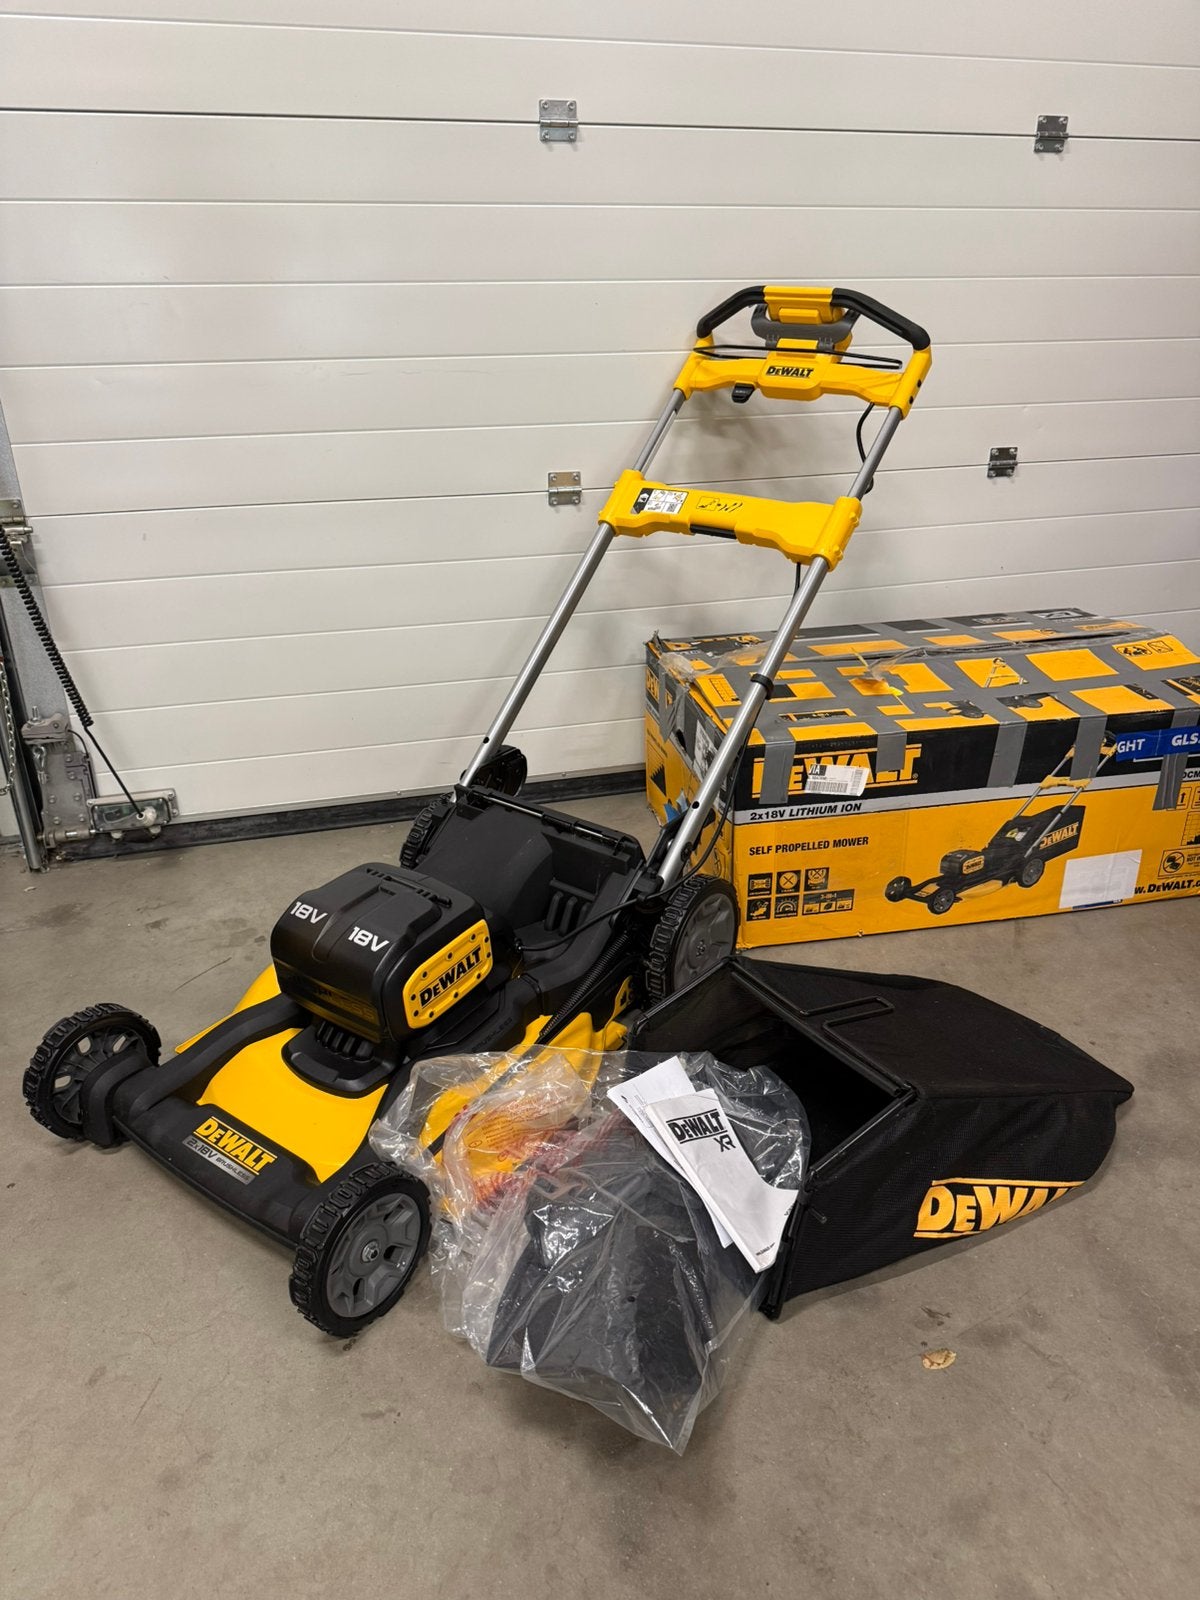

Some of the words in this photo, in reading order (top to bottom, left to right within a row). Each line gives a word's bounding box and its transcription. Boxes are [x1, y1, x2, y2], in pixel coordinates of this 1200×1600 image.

[766, 365, 814, 379] DEWALT
[750, 809, 786, 821] 2x18V
[788, 804, 838, 818] LITHIUM
[840, 802, 863, 813] ION
[748, 845, 773, 856] SELF
[774, 839, 830, 854] PROPELLED
[832, 836, 869, 848] MOWER
[289, 900, 329, 925] 18V
[347, 926, 390, 953] 18V
[418, 945, 483, 1008] DEWALT
[666, 1110, 727, 1143] DEWALT
[186, 1137, 218, 1160] 2x18V
[193, 1116, 277, 1175] DEWALT
